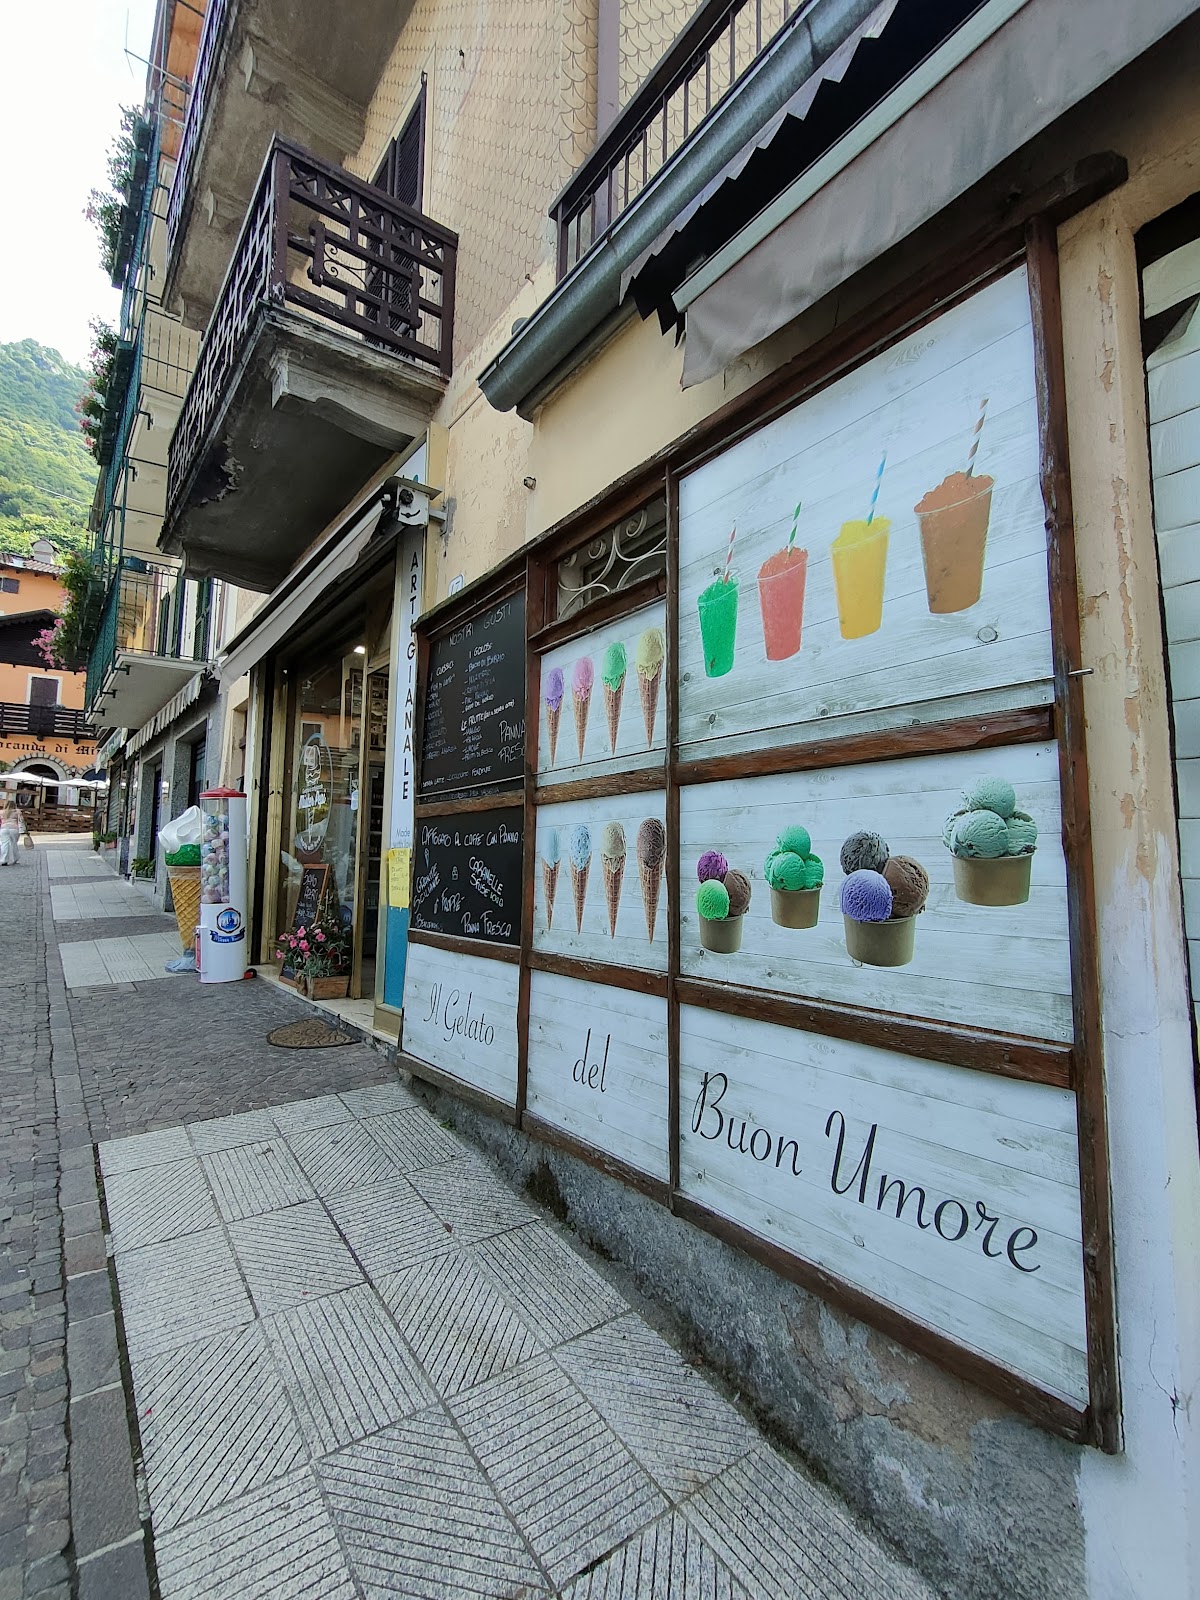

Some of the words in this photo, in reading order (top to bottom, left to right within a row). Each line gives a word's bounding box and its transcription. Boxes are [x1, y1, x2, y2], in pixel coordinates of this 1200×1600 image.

[449, 622, 474, 647] NOSTRI
[483, 602, 511, 629] GUSTI
[402, 551, 419, 800] ARTIGIANALE
[498, 719, 525, 744] PANNA
[55, 743, 68, 754] di
[76, 745, 101, 755] Mi
[396, 827, 410, 837] Made
[421, 825, 452, 847] AFFOGATO
[498, 823, 519, 845] PANNA
[468, 856, 504, 896] CARAMELLE
[460, 911, 480, 934] PANNA
[480, 909, 512, 937] FRESCA
[423, 982, 443, 1026] Il
[443, 989, 494, 1046] Gelato
[573, 1027, 611, 1093] del
[691, 1071, 803, 1176] Buon
[825, 1110, 1042, 1273] Umore
